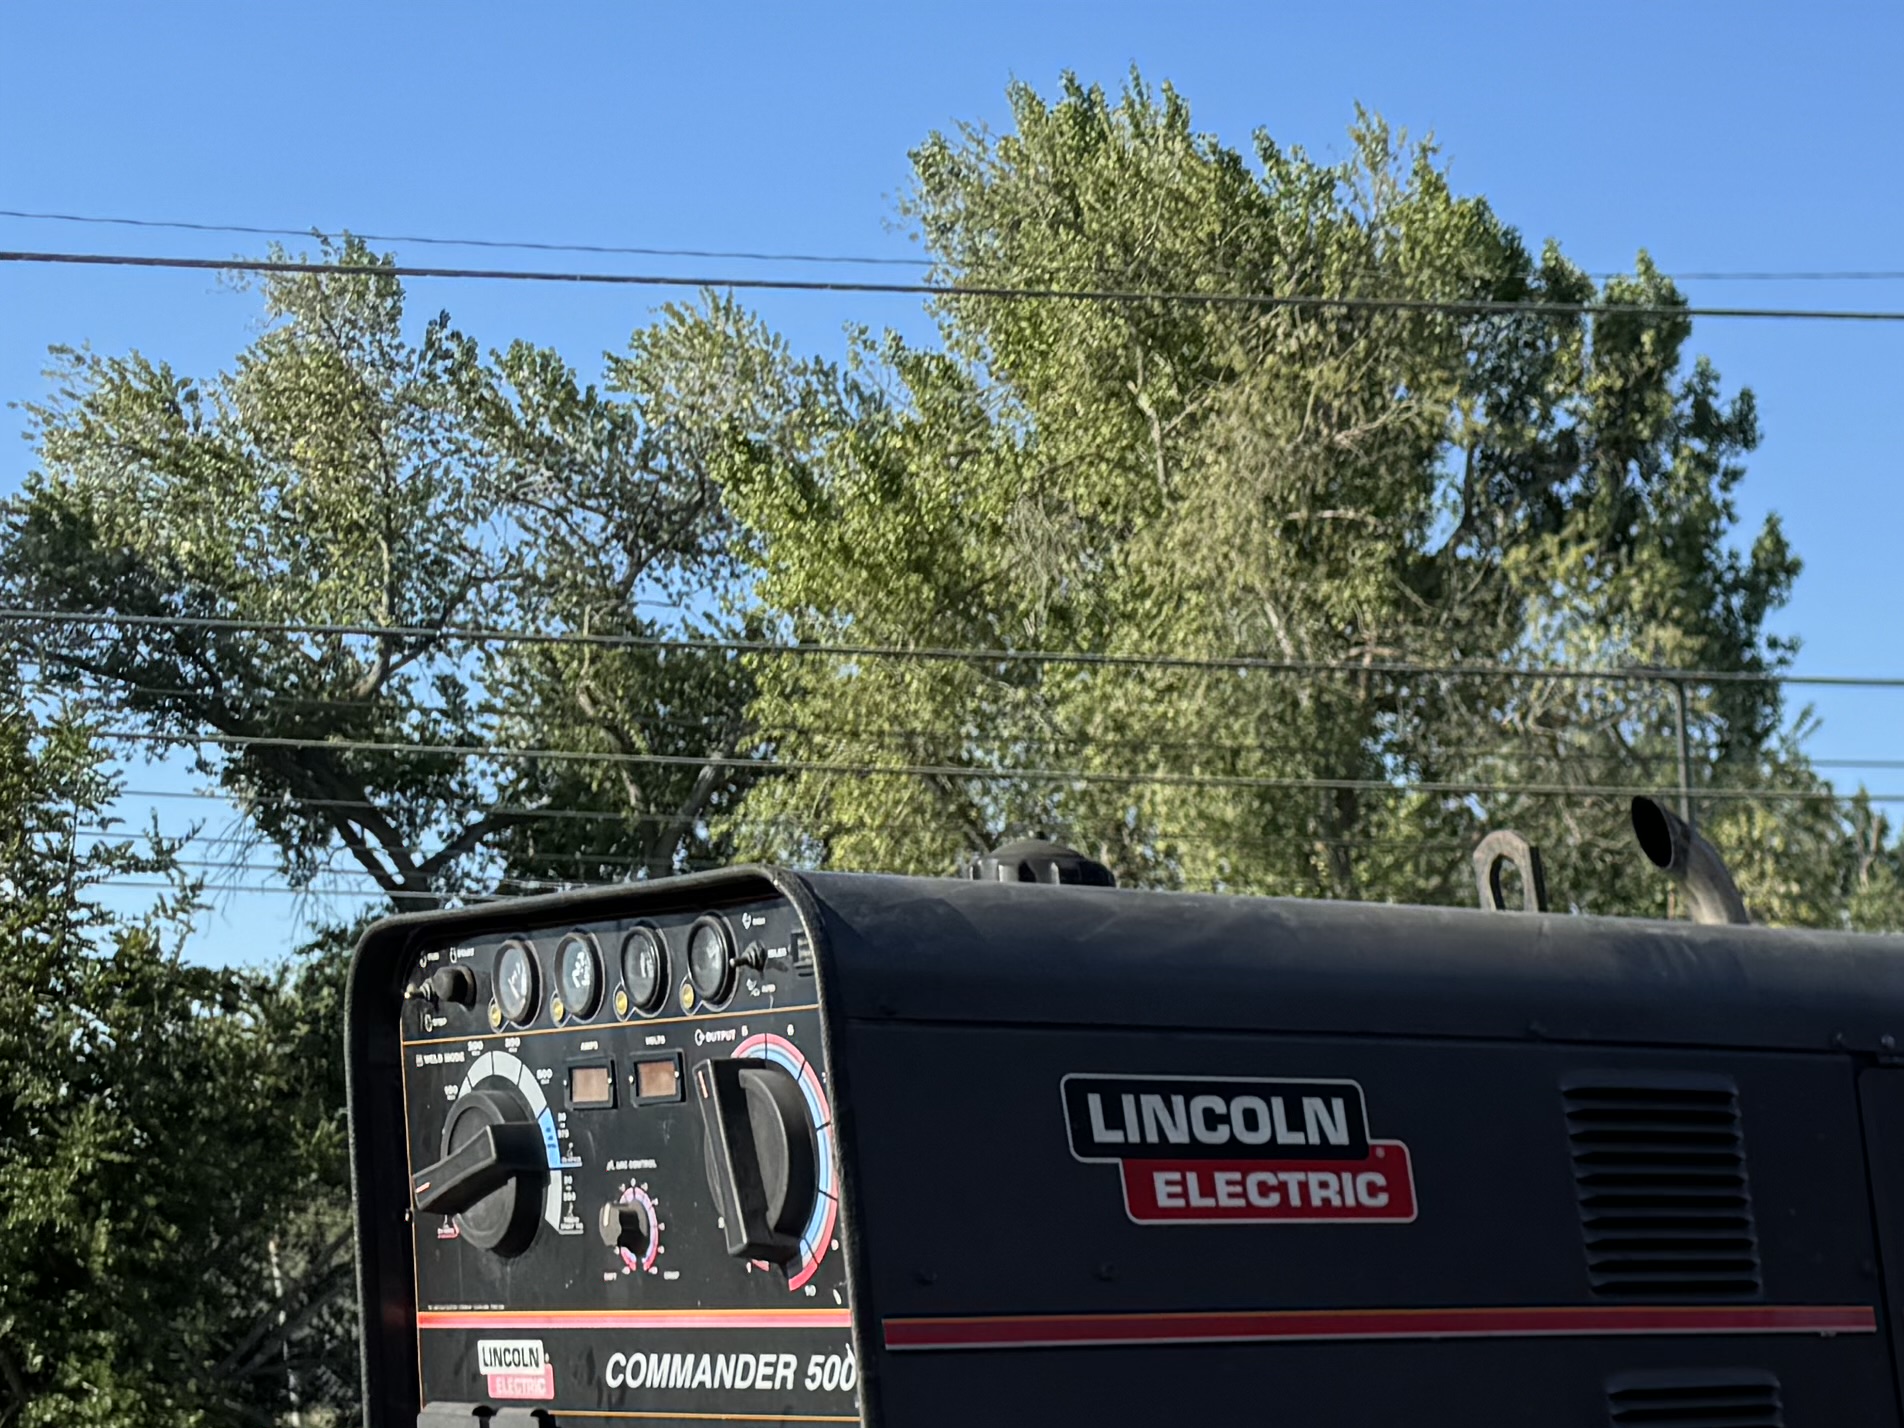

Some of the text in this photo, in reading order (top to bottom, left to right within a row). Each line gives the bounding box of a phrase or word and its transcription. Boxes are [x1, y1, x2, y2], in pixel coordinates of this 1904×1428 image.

[705, 1028, 736, 1044] OUTPUT
[1087, 1092, 1351, 1146] LINCOLN
[1153, 1171, 1390, 1209] ELECTRIC
[482, 1346, 540, 1368] LINCOLN
[605, 1352, 856, 1392] COMMANDER 500
[496, 1377, 547, 1395] ELECTRIC
